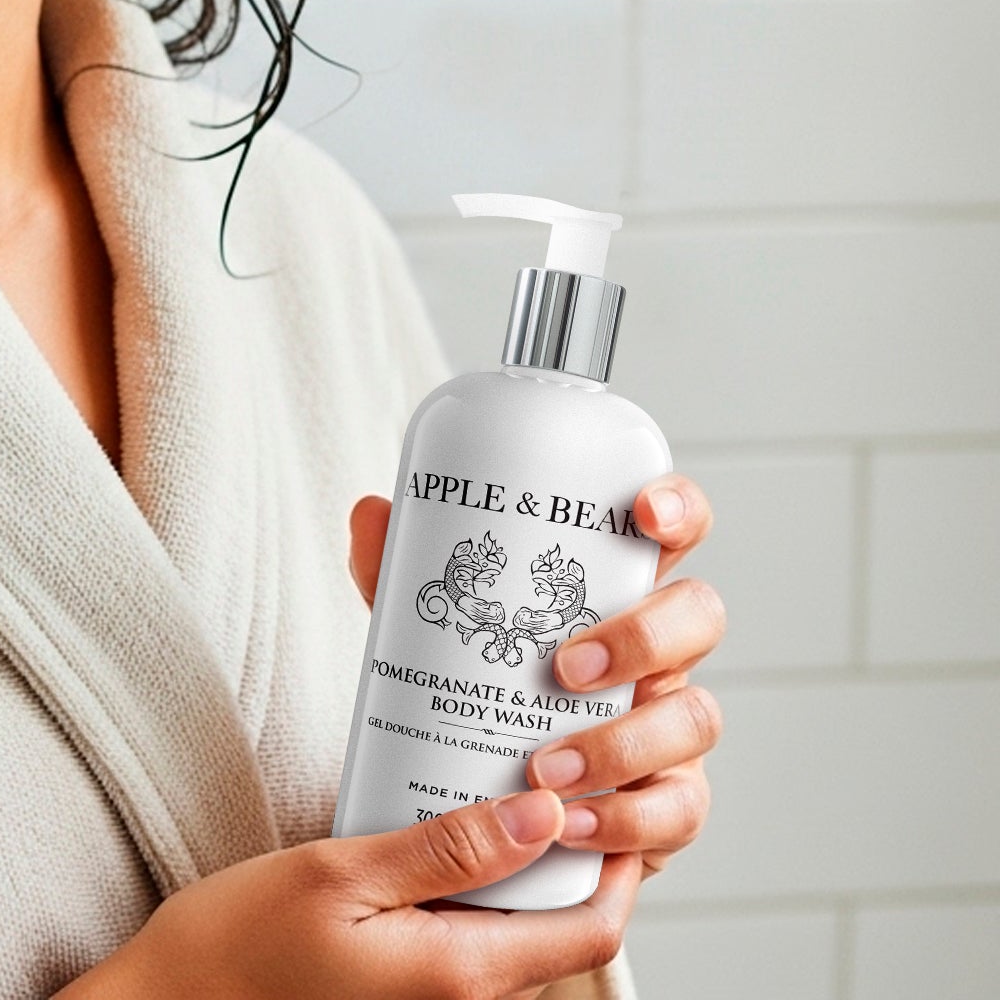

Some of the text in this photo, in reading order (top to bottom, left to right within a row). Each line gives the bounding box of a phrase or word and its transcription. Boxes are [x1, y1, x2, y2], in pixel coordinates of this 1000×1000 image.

[405, 471, 650, 540] APPLE & BEAR
[370, 659, 621, 718] POMEGRANATE & ALOE VERA
[430, 695, 553, 732] BODY WASH
[368, 716, 384, 729] GEL
[385, 721, 432, 743] DOUCHE
[433, 731, 441, 744] À
[444, 735, 458, 748] LA
[460, 739, 519, 759] GRENADE
[408, 780, 449, 798] MADE
[453, 791, 469, 802] IN
